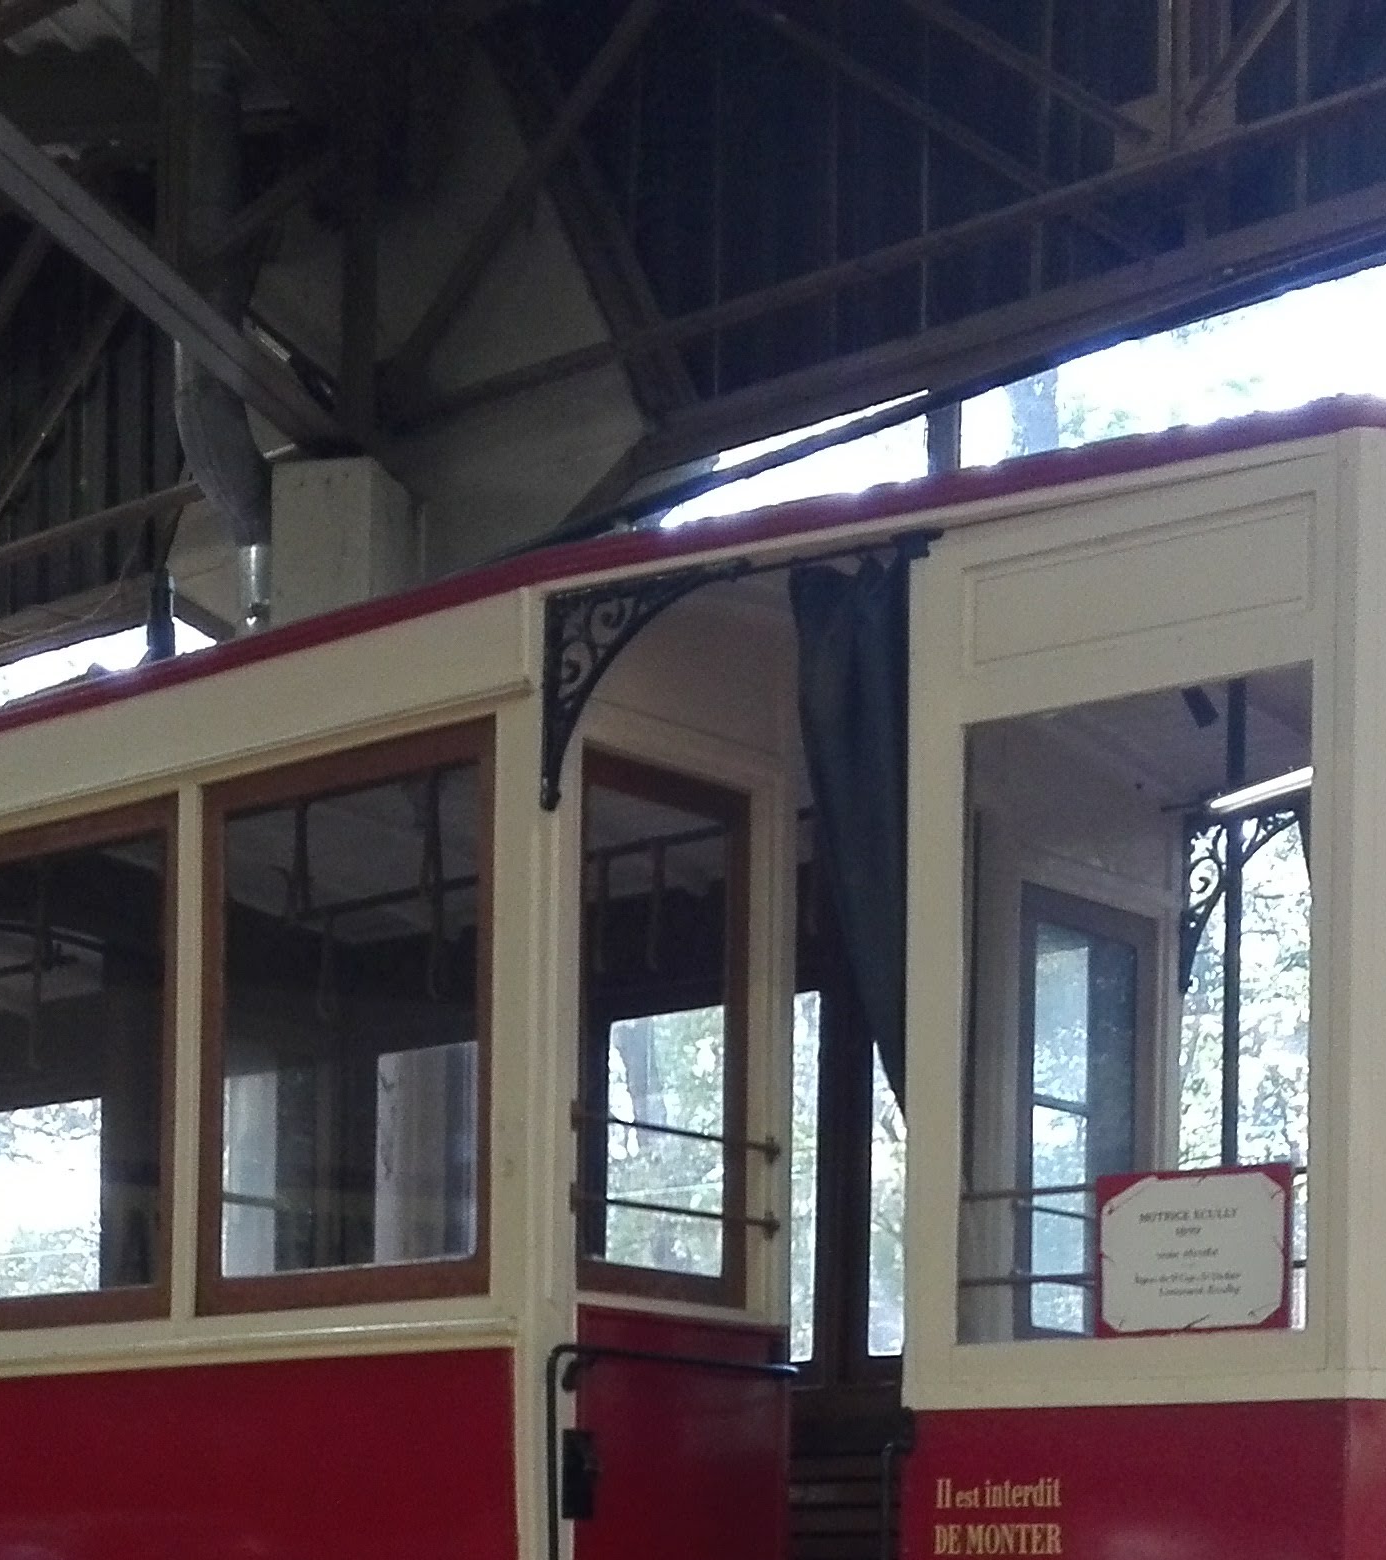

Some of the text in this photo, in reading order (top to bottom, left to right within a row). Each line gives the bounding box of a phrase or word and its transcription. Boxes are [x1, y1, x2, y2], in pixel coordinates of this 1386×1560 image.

[936, 1478, 1062, 1508] Il est interdit
[933, 1522, 1062, 1555] DE MONTER
